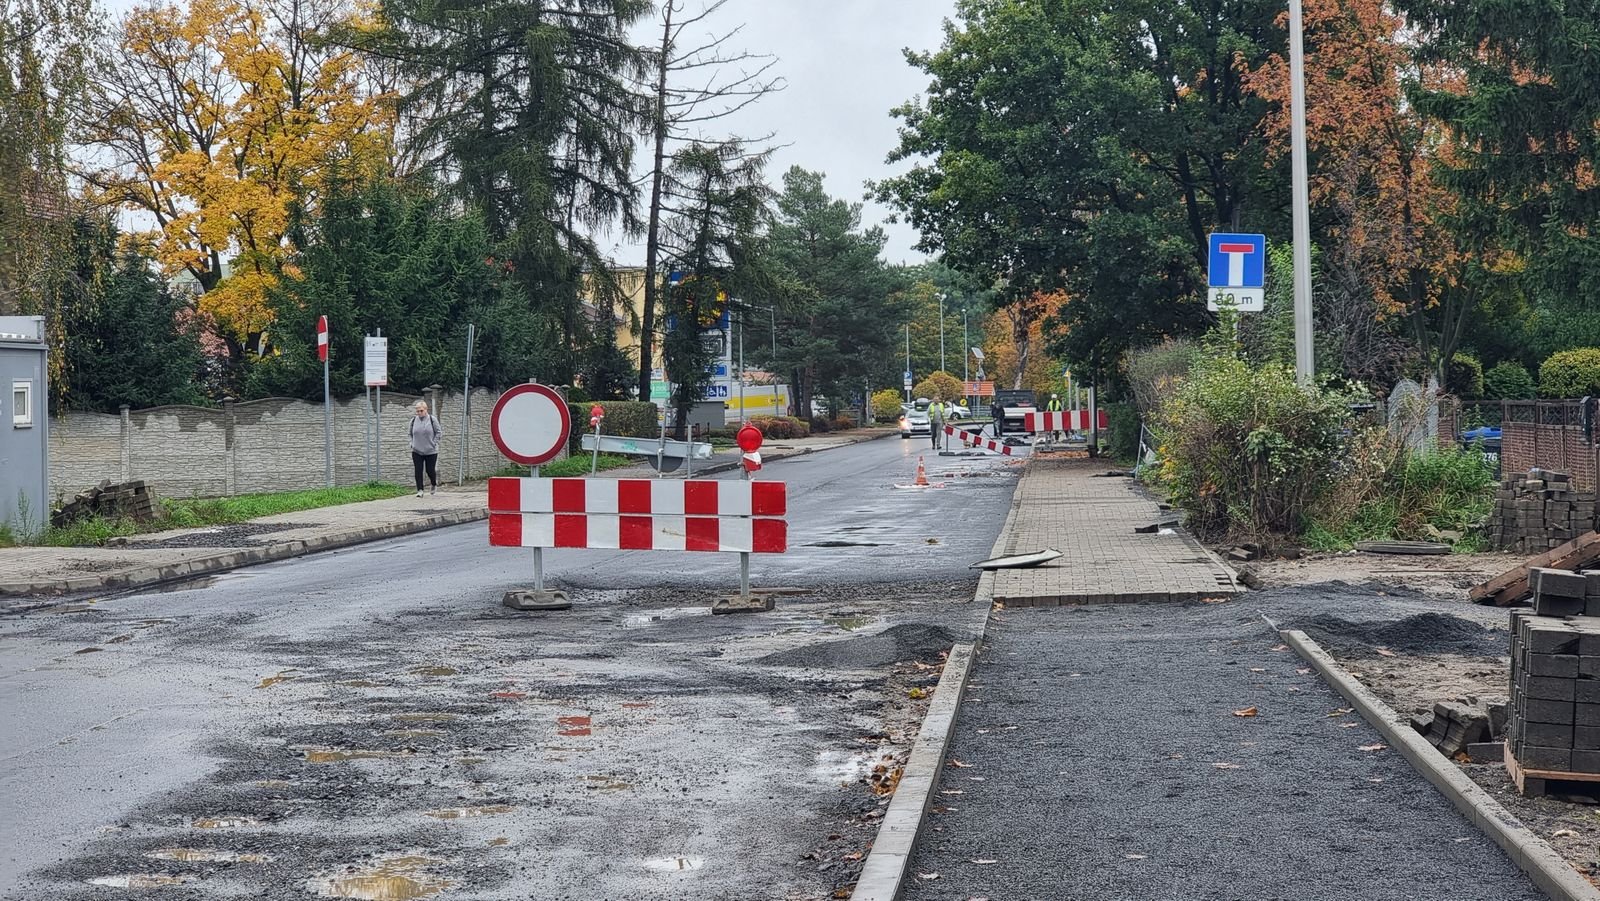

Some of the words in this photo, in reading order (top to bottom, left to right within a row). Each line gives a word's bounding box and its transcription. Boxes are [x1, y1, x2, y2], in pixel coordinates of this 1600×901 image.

[1215, 293, 1235, 306] 80
[1241, 296, 1253, 305] m
[1482, 452, 1498, 462] 276
